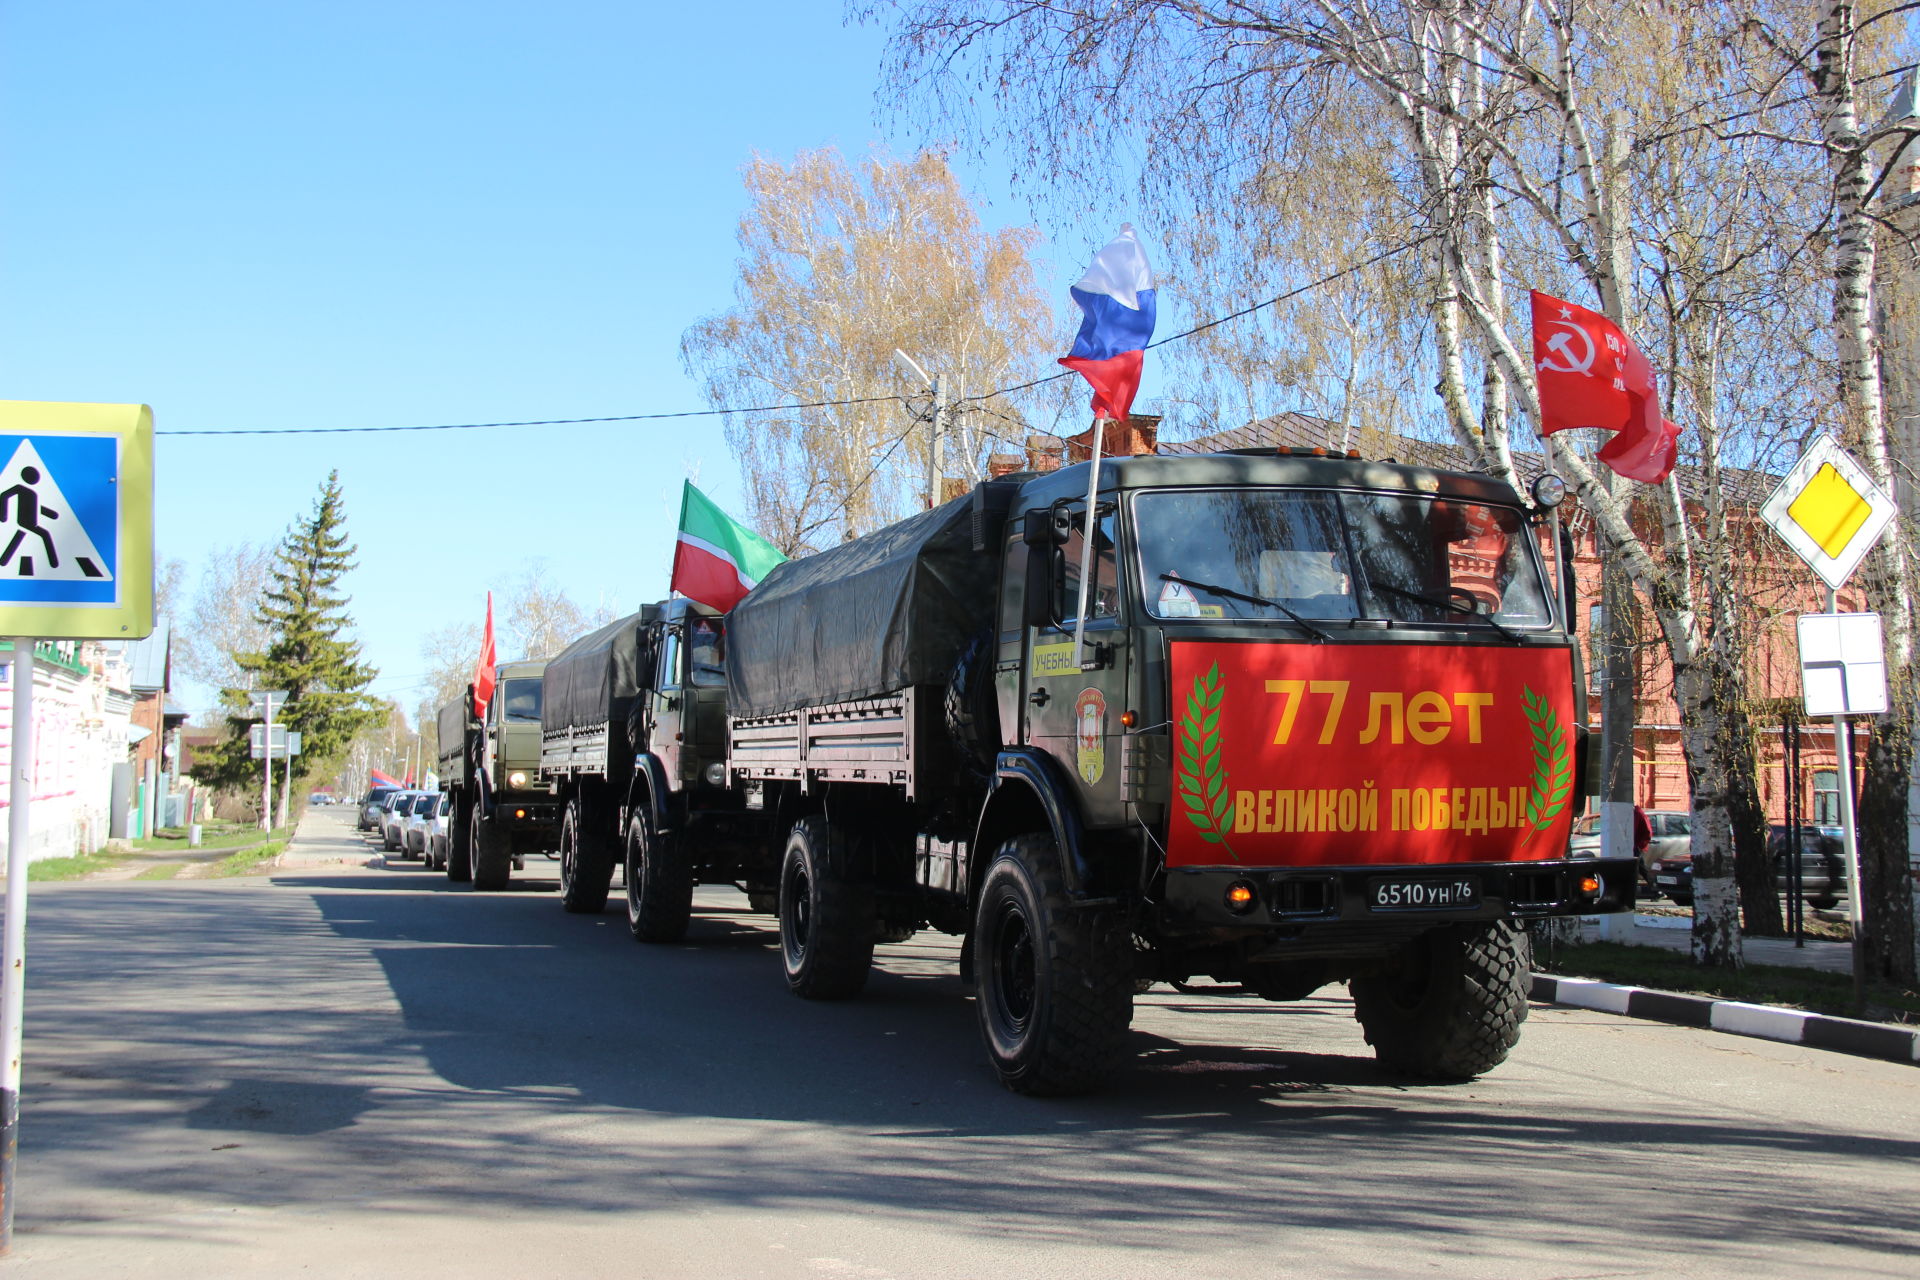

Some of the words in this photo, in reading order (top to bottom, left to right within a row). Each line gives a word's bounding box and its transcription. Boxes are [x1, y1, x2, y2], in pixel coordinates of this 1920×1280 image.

[1035, 650, 1074, 671] УЧЕБНЫ
[1265, 680, 1350, 744] 77
[1359, 690, 1494, 745] лет
[1235, 779, 1378, 833] ВЕЛИКОЙ
[1391, 786, 1527, 836] ПОБЕДЫ!
[1377, 884, 1424, 904] 6510
[1428, 888, 1449, 903] УН
[1454, 882, 1472, 897] 76
